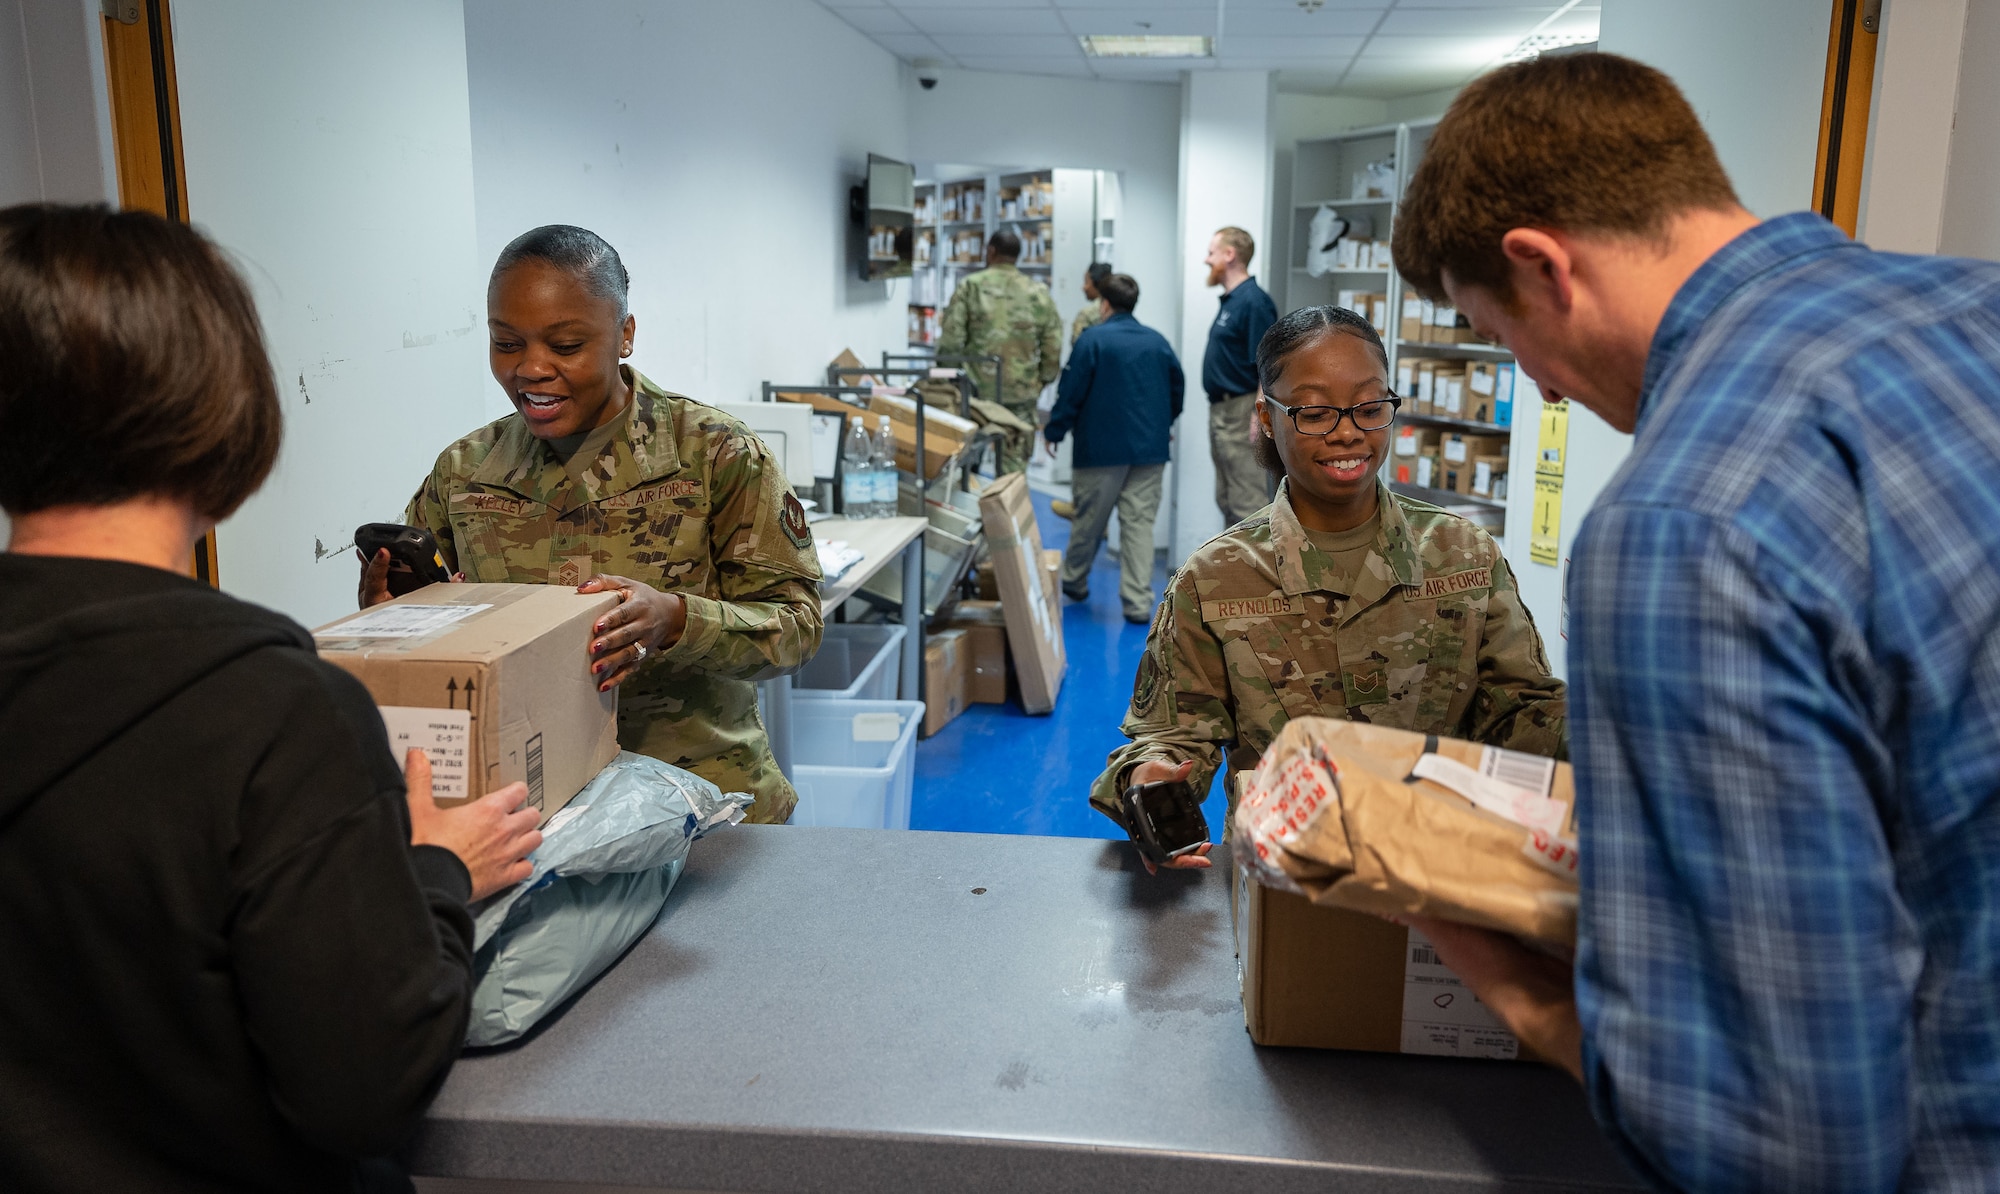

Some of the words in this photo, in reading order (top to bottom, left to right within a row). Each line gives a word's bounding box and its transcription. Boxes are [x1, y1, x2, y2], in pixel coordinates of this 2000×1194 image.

[475, 494, 526, 515] KELLEY
[635, 490, 654, 507] AIR
[658, 481, 697, 501] FORCE
[1425, 578, 1447, 598] AIR
[1449, 569, 1490, 592] FORCE
[1218, 597, 1291, 618] REYNOLDS
